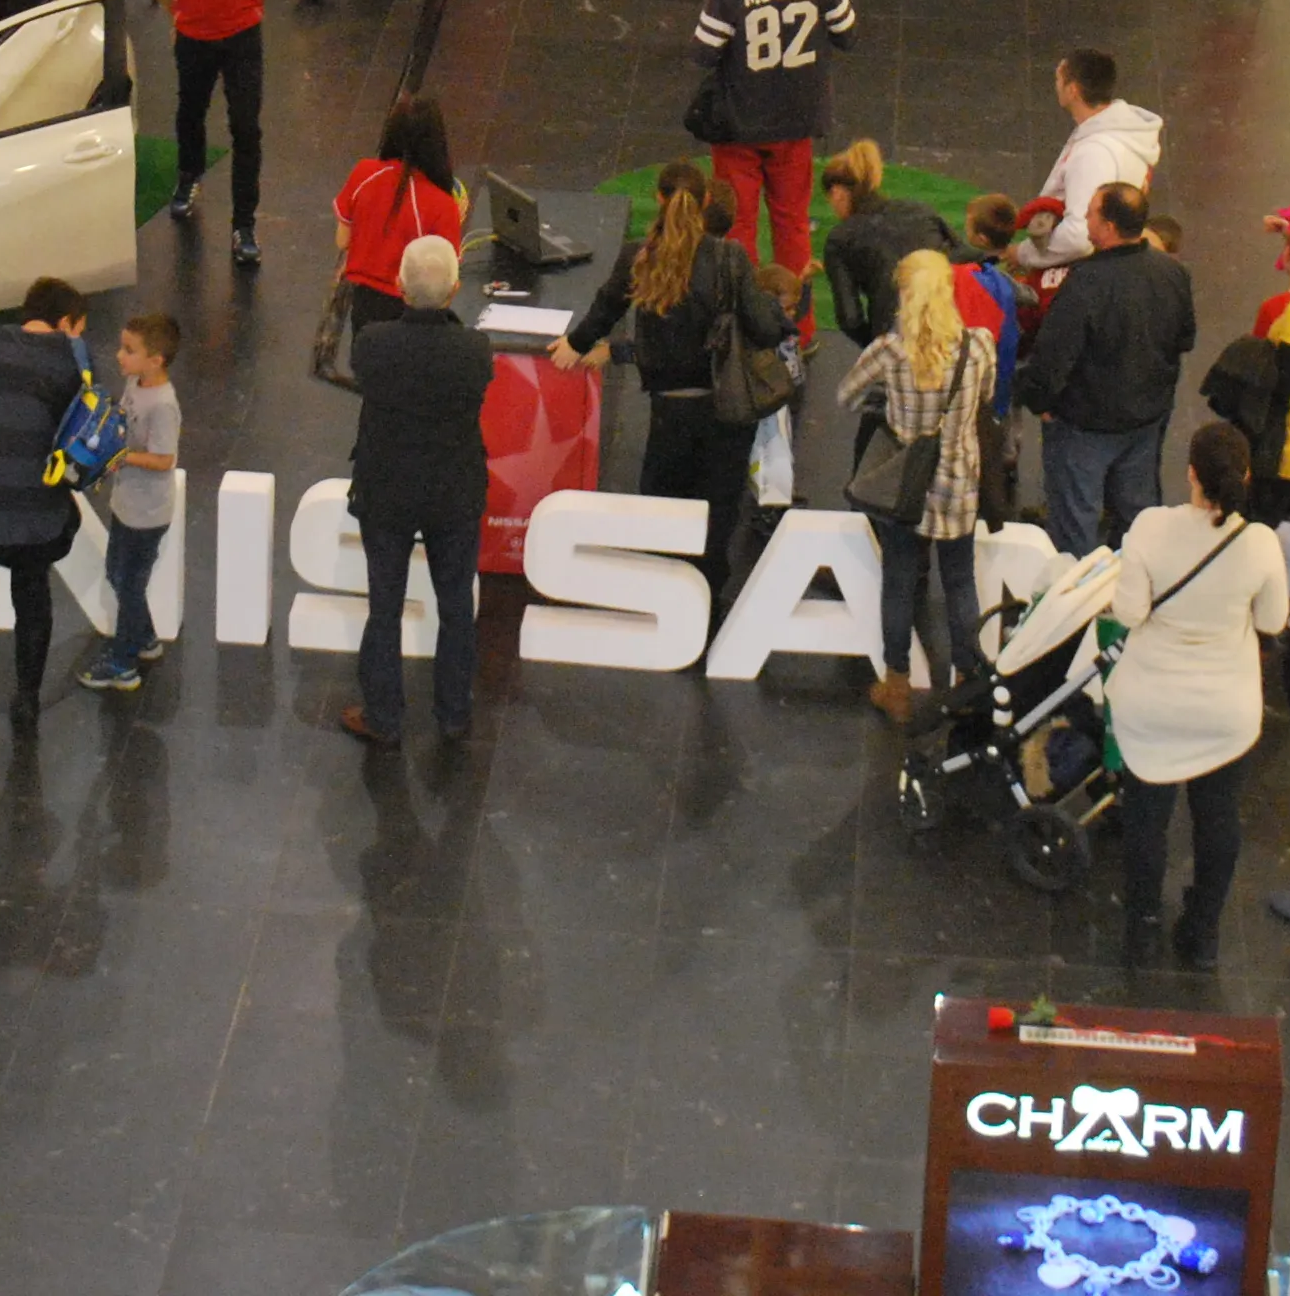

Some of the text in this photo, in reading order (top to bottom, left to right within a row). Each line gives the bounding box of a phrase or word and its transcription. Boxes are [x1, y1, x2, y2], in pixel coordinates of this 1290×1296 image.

[743, 0, 820, 73] 82
[487, 516, 531, 528] NISSA
[965, 1083, 1245, 1159] CHARM
